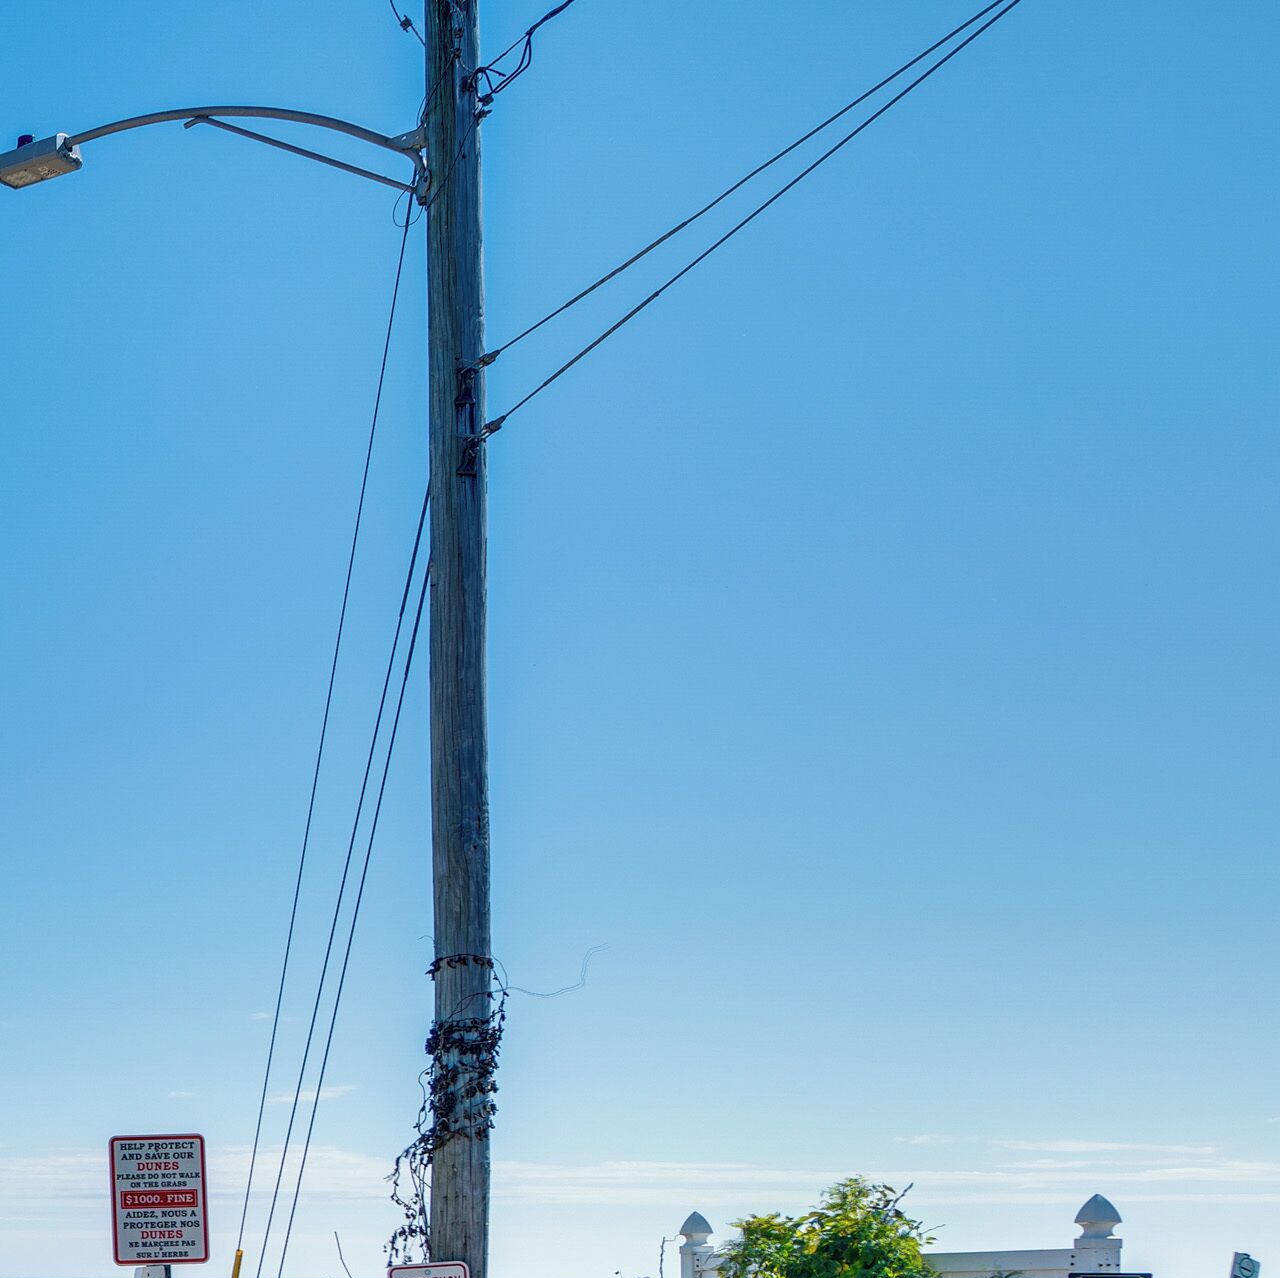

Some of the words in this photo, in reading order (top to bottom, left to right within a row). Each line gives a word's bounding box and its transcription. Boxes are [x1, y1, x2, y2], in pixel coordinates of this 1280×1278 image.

[120, 1143, 145, 1151] HELP
[148, 1141, 194, 1150] PROTECT
[145, 1152, 170, 1160] SAVE
[137, 1162, 179, 1171] DUNES
[167, 1194, 194, 1203] FINE
[126, 1211, 158, 1219] AIDEZ,
[161, 1210, 187, 1218] NOUS
[123, 1221, 177, 1229] PROTEGER
[180, 1220, 200, 1228] NOS
[141, 1230, 184, 1239] DUNES
